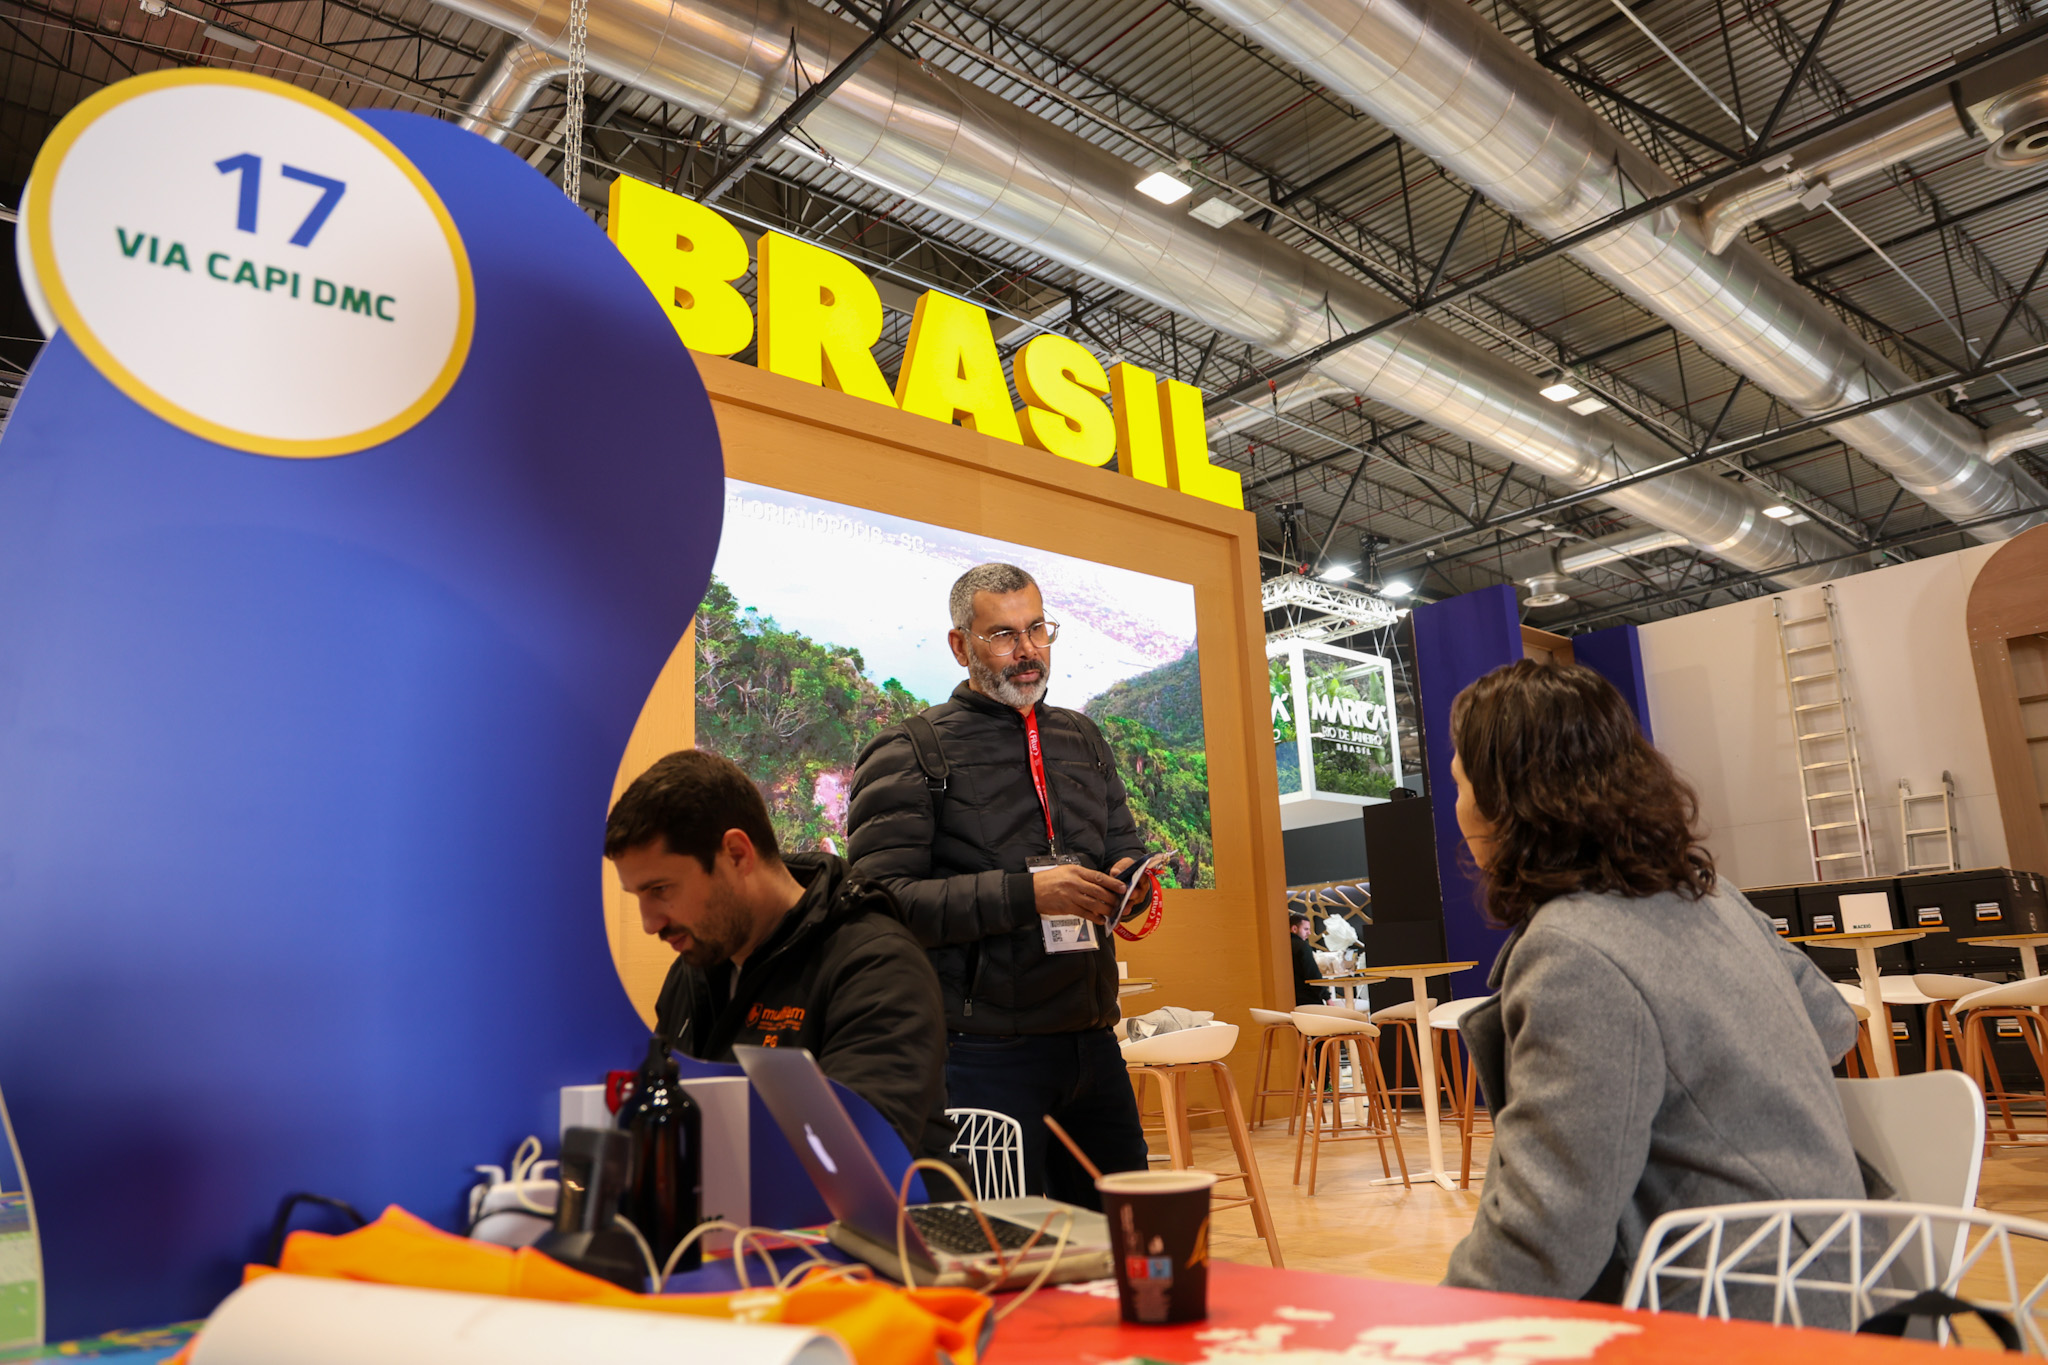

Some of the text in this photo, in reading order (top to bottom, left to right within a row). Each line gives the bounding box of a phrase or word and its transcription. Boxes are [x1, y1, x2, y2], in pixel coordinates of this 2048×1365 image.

[214, 151, 348, 248] 17
[115, 226, 397, 324] VIA CAPI DMC
[608, 174, 1244, 511] BRASIL
[899, 531, 927, 555] SC
[1311, 691, 1389, 733] MARICÁ
[1322, 725, 1383, 746] RIO DE JANEIRO
[1336, 743, 1371, 756] BRASIL
